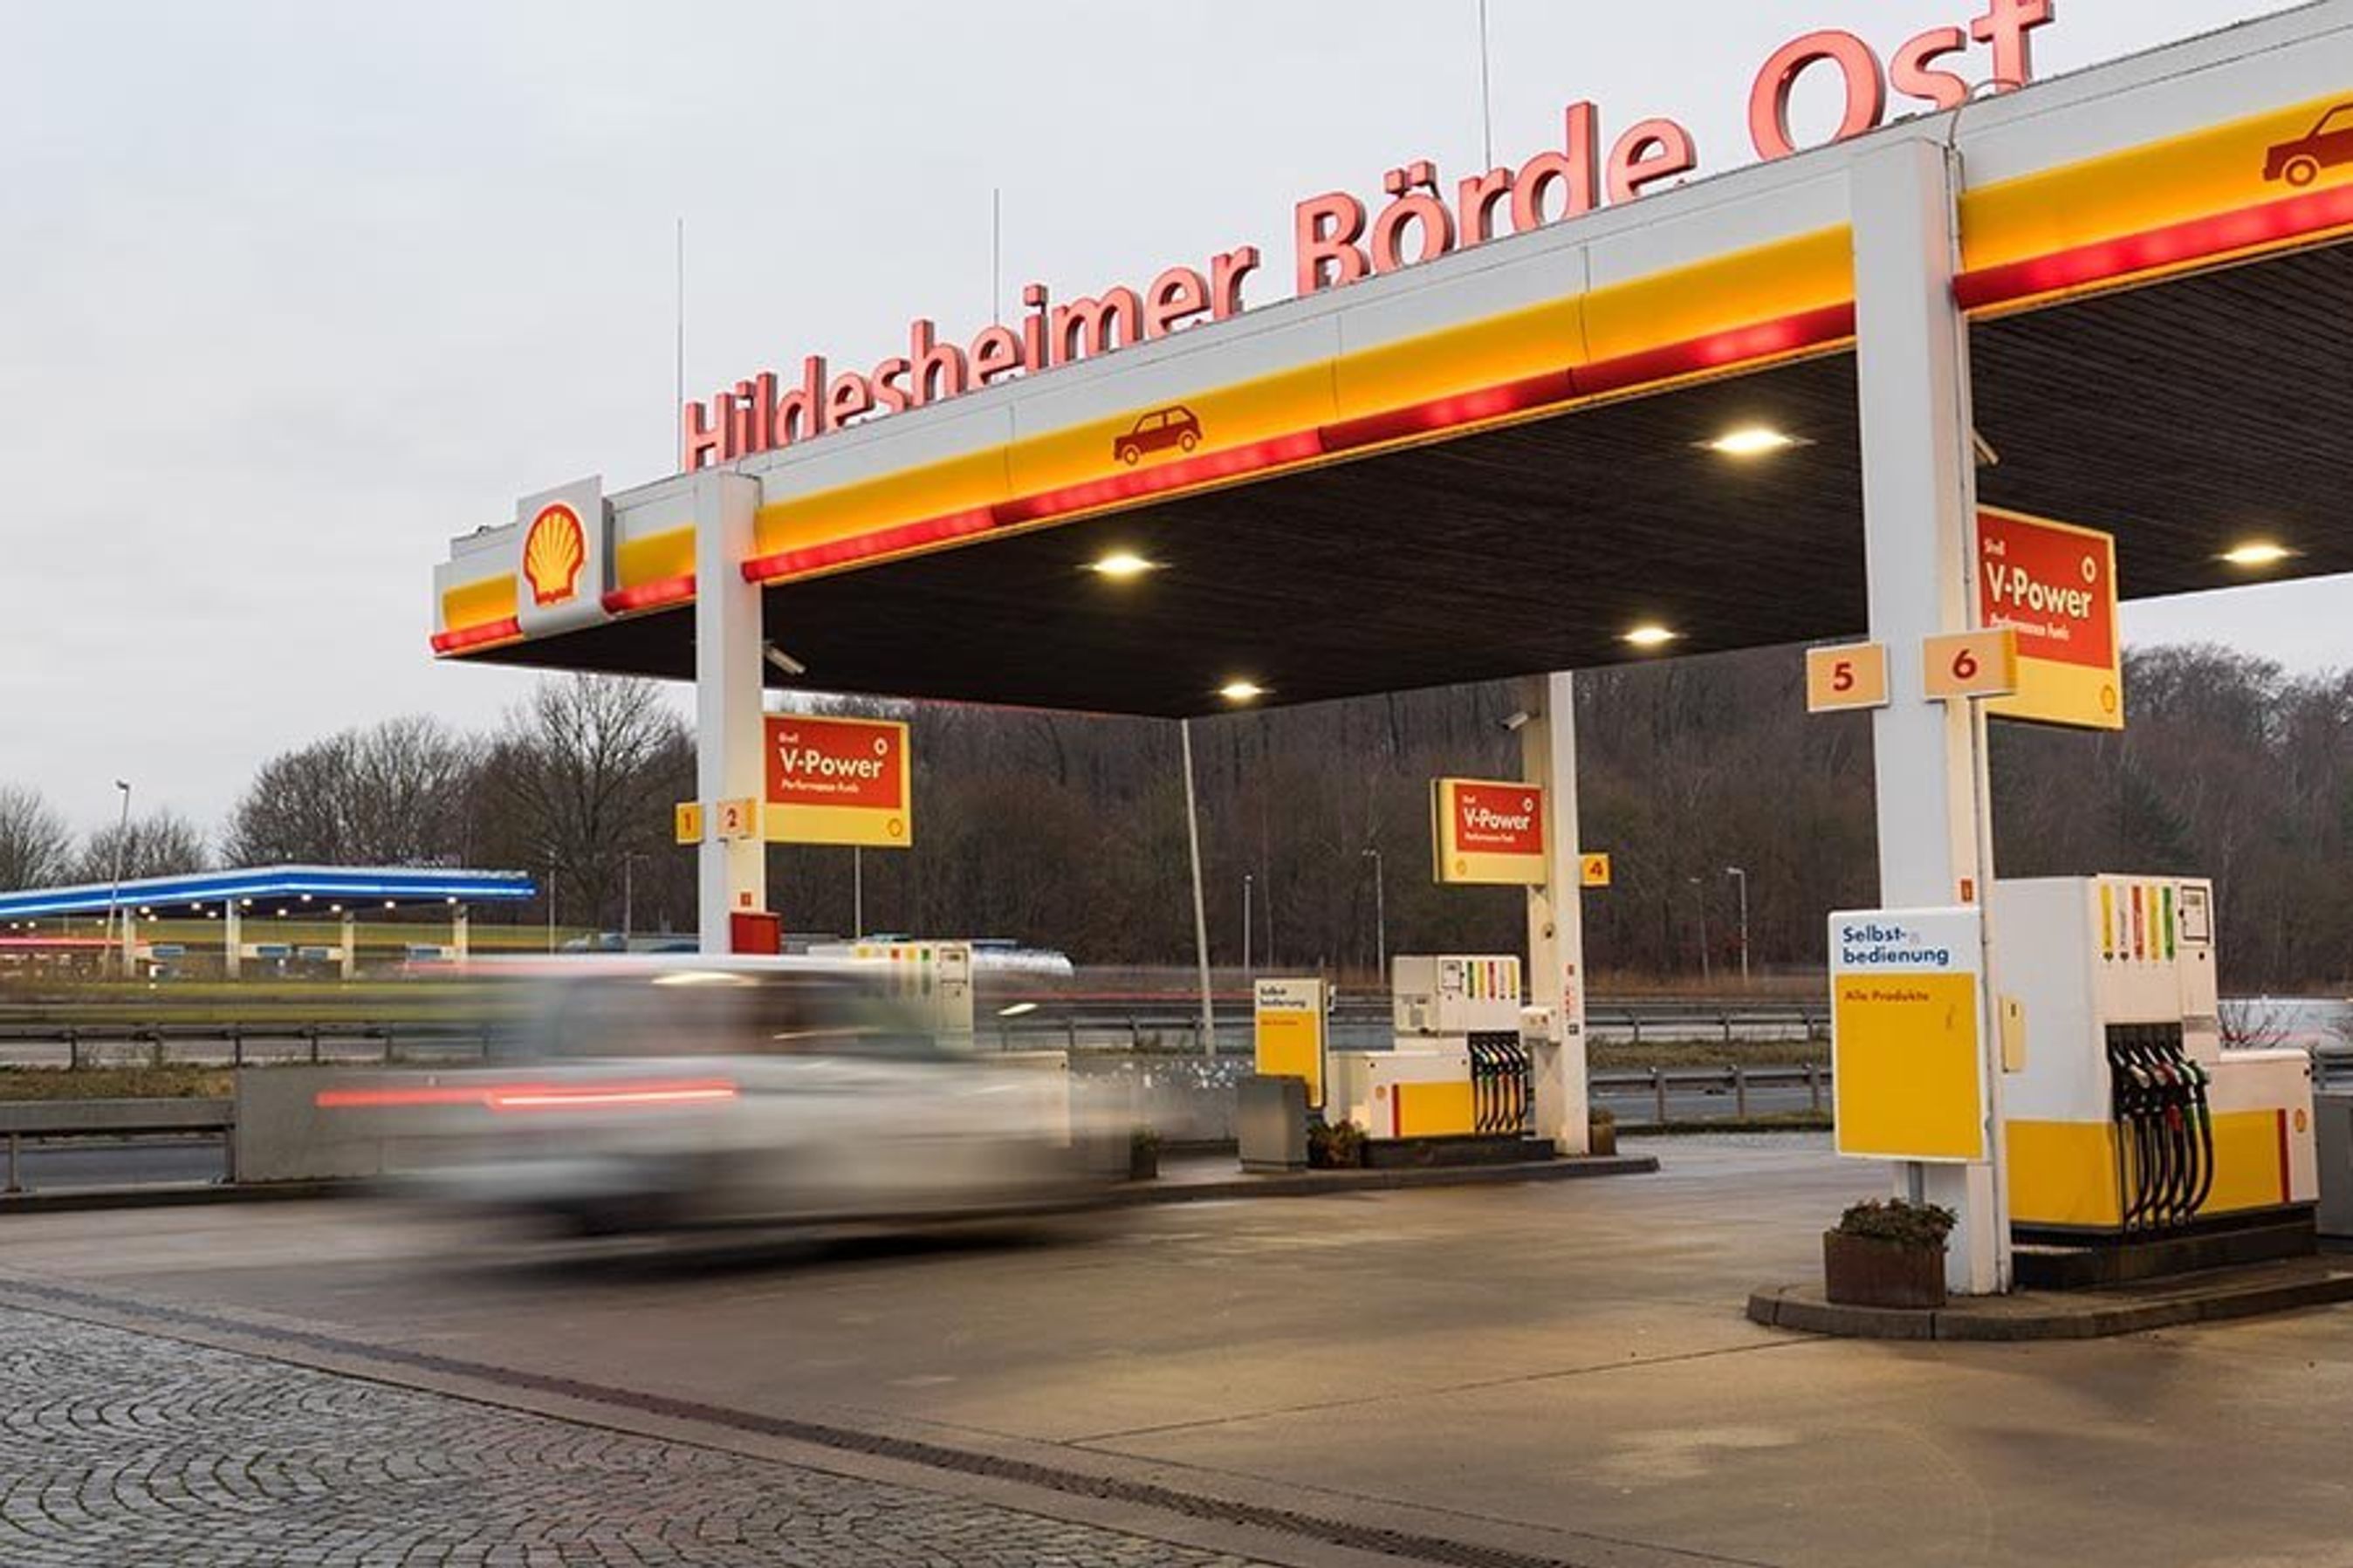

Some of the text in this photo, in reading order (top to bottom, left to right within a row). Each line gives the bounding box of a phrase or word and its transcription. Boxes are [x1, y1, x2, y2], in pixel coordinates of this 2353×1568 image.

[683, 0, 2055, 472] Hildesheimer Börde Ost
[1986, 560, 2093, 619] V-Power
[1833, 661, 1853, 691] 5
[1952, 648, 1977, 680] 6
[779, 747, 883, 778] V-Power
[727, 807, 737, 828] 2
[1464, 807, 1531, 830] V-Power
[1589, 861, 1603, 877] 4
[1842, 946, 1949, 966] bedienung
